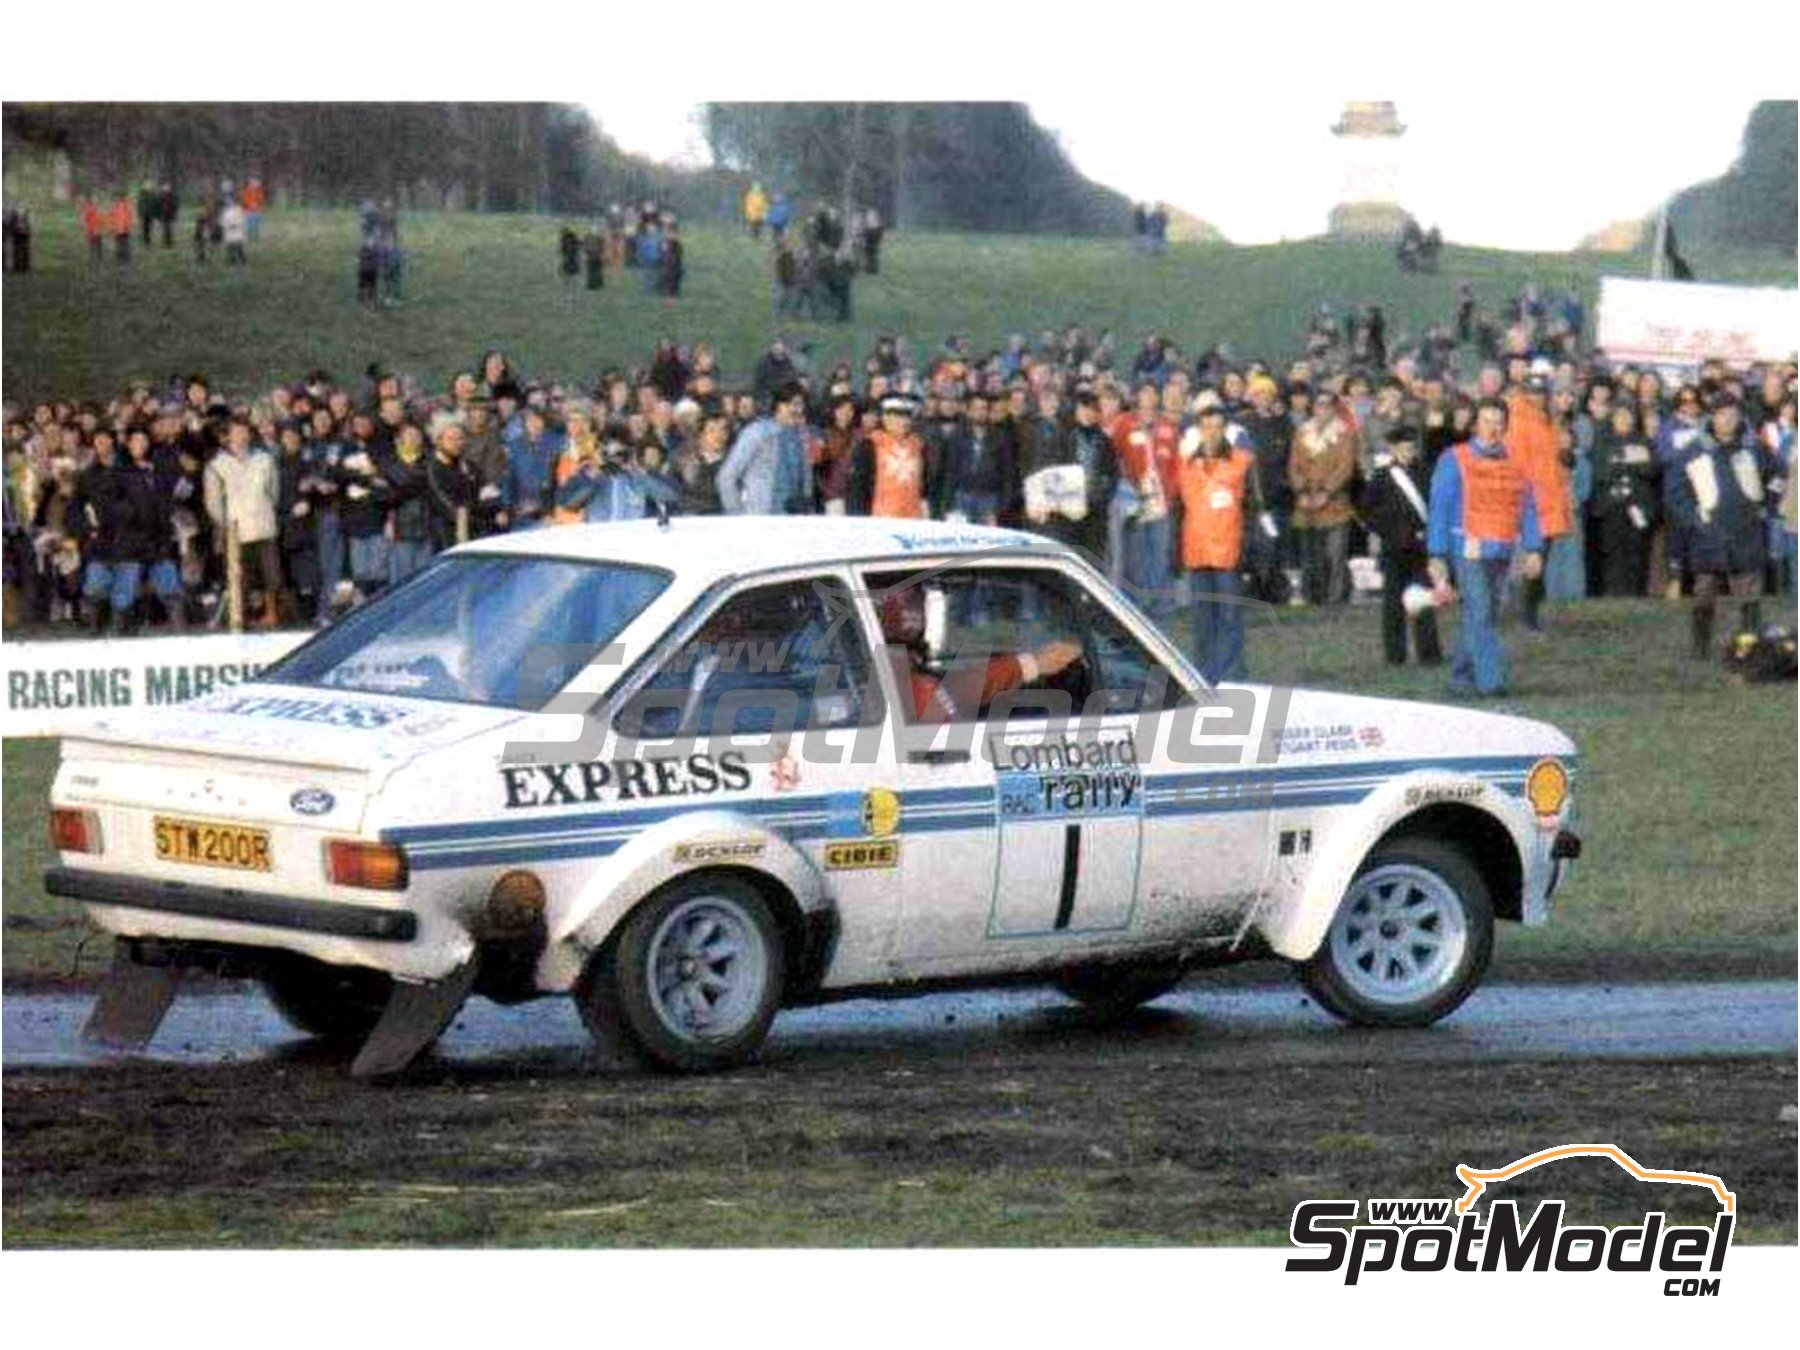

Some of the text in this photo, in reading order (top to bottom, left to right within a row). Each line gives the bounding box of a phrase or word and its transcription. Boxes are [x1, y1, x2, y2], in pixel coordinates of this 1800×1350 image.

[8, 668, 132, 710] RACING
[988, 731, 1138, 771] Lombard
[500, 751, 752, 809] EXPRESS
[1042, 774, 1140, 811] rally
[1054, 824, 1082, 930] 1
